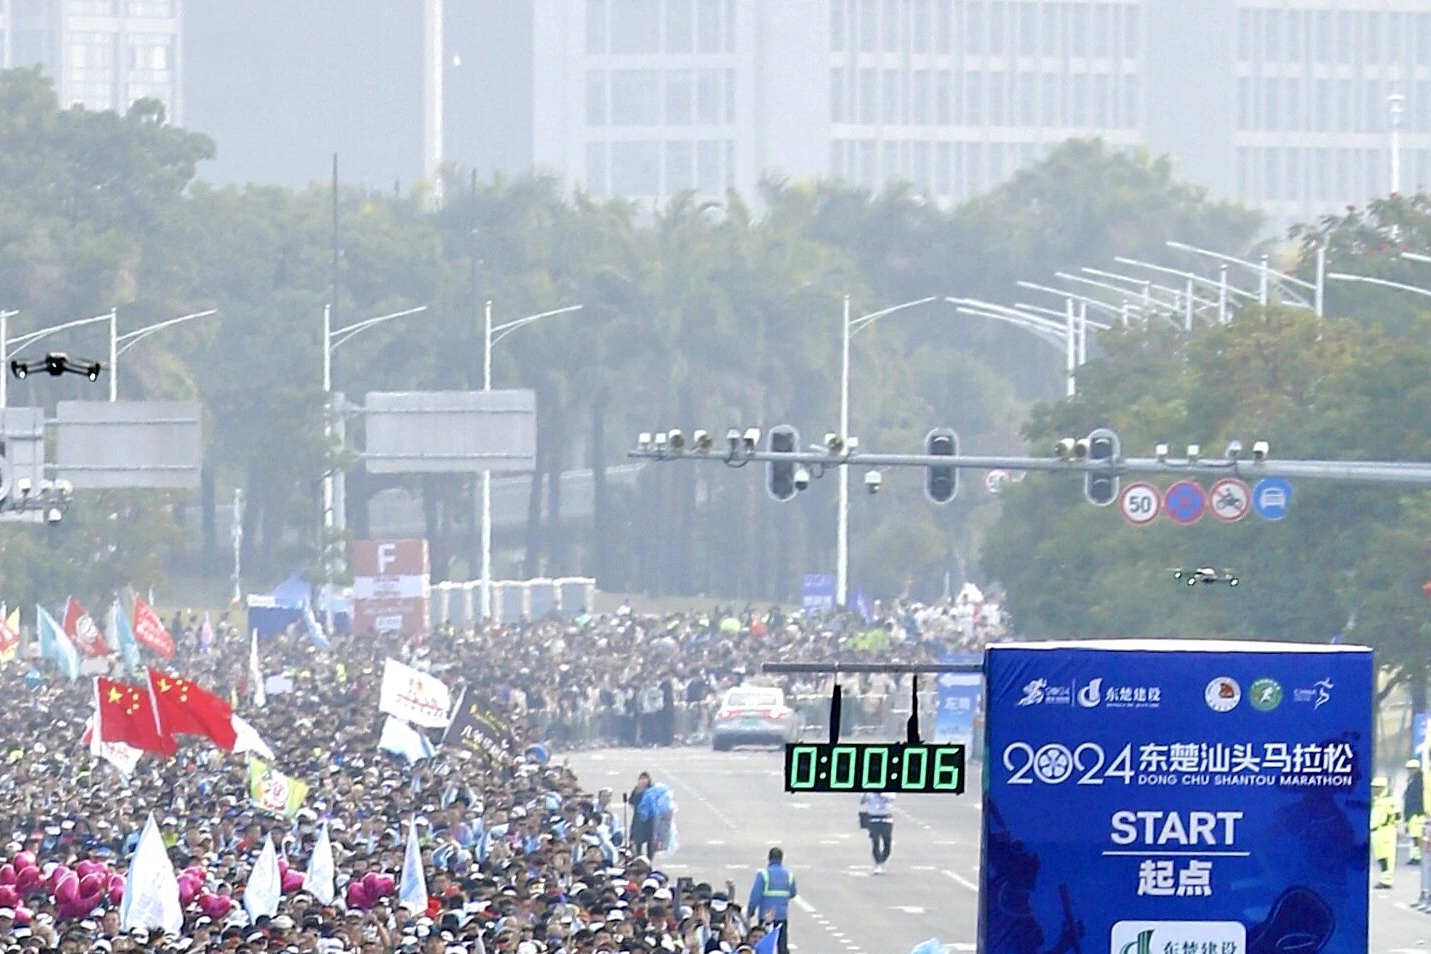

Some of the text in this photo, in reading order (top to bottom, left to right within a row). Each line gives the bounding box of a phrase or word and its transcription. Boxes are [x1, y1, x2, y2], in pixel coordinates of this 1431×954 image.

[1129, 495, 1152, 515] 50
[377, 543, 396, 573] F
[1105, 687, 1161, 702] 东楚建设
[790, 746, 960, 790] 0:00:06
[1002, 740, 1135, 785] 2024
[1138, 742, 1354, 774] 东楚汕头马拉松
[1138, 775, 1353, 787] DONG CHU SHANTOU MARATHON
[1110, 810, 1244, 846] START
[1136, 860, 1213, 897] 起点
